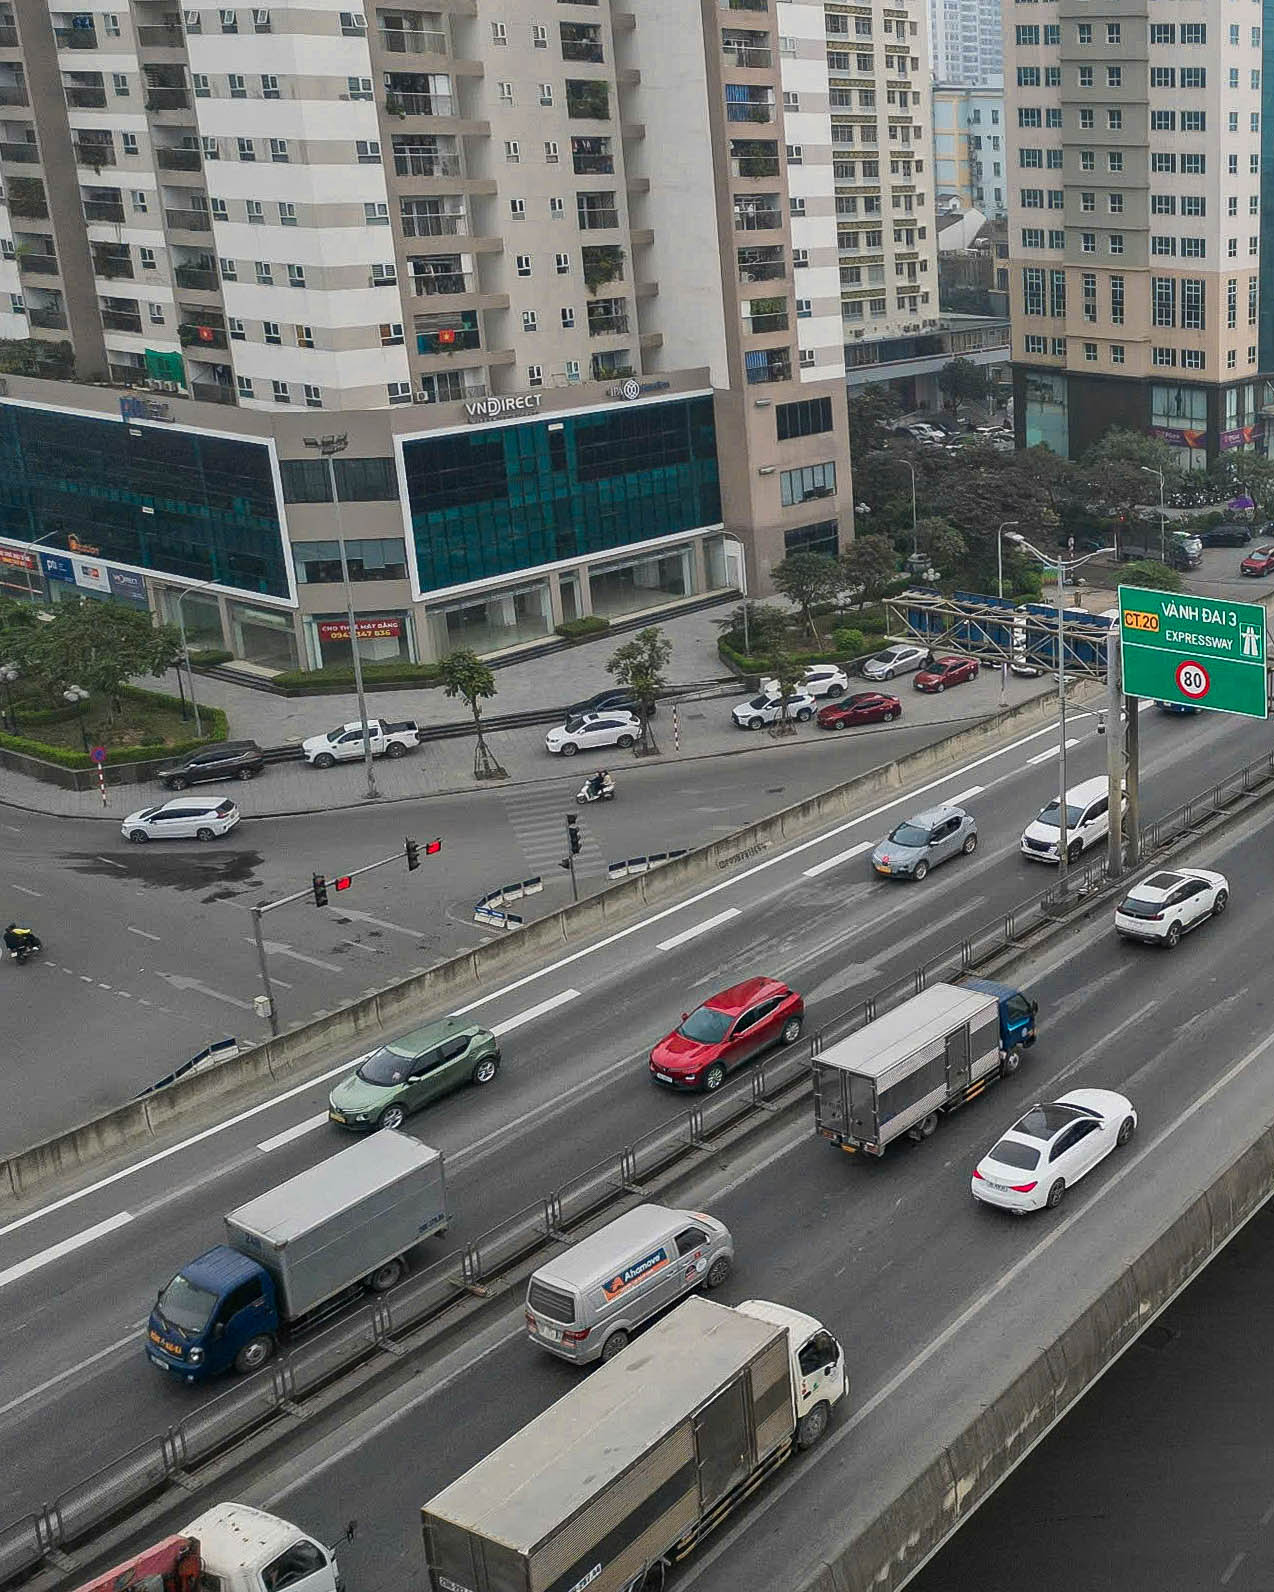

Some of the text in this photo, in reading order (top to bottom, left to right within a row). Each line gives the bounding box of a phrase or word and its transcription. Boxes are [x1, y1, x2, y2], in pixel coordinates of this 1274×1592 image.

[466, 394, 542, 416] VNDIRECT
[1125, 612, 1158, 630] CT.20
[1161, 600, 1237, 627] VÀNH ĐAI 3
[1165, 630, 1233, 650] EXPRESSWAY
[1184, 671, 1202, 689] 80
[624, 1254, 661, 1283] Ahamove
